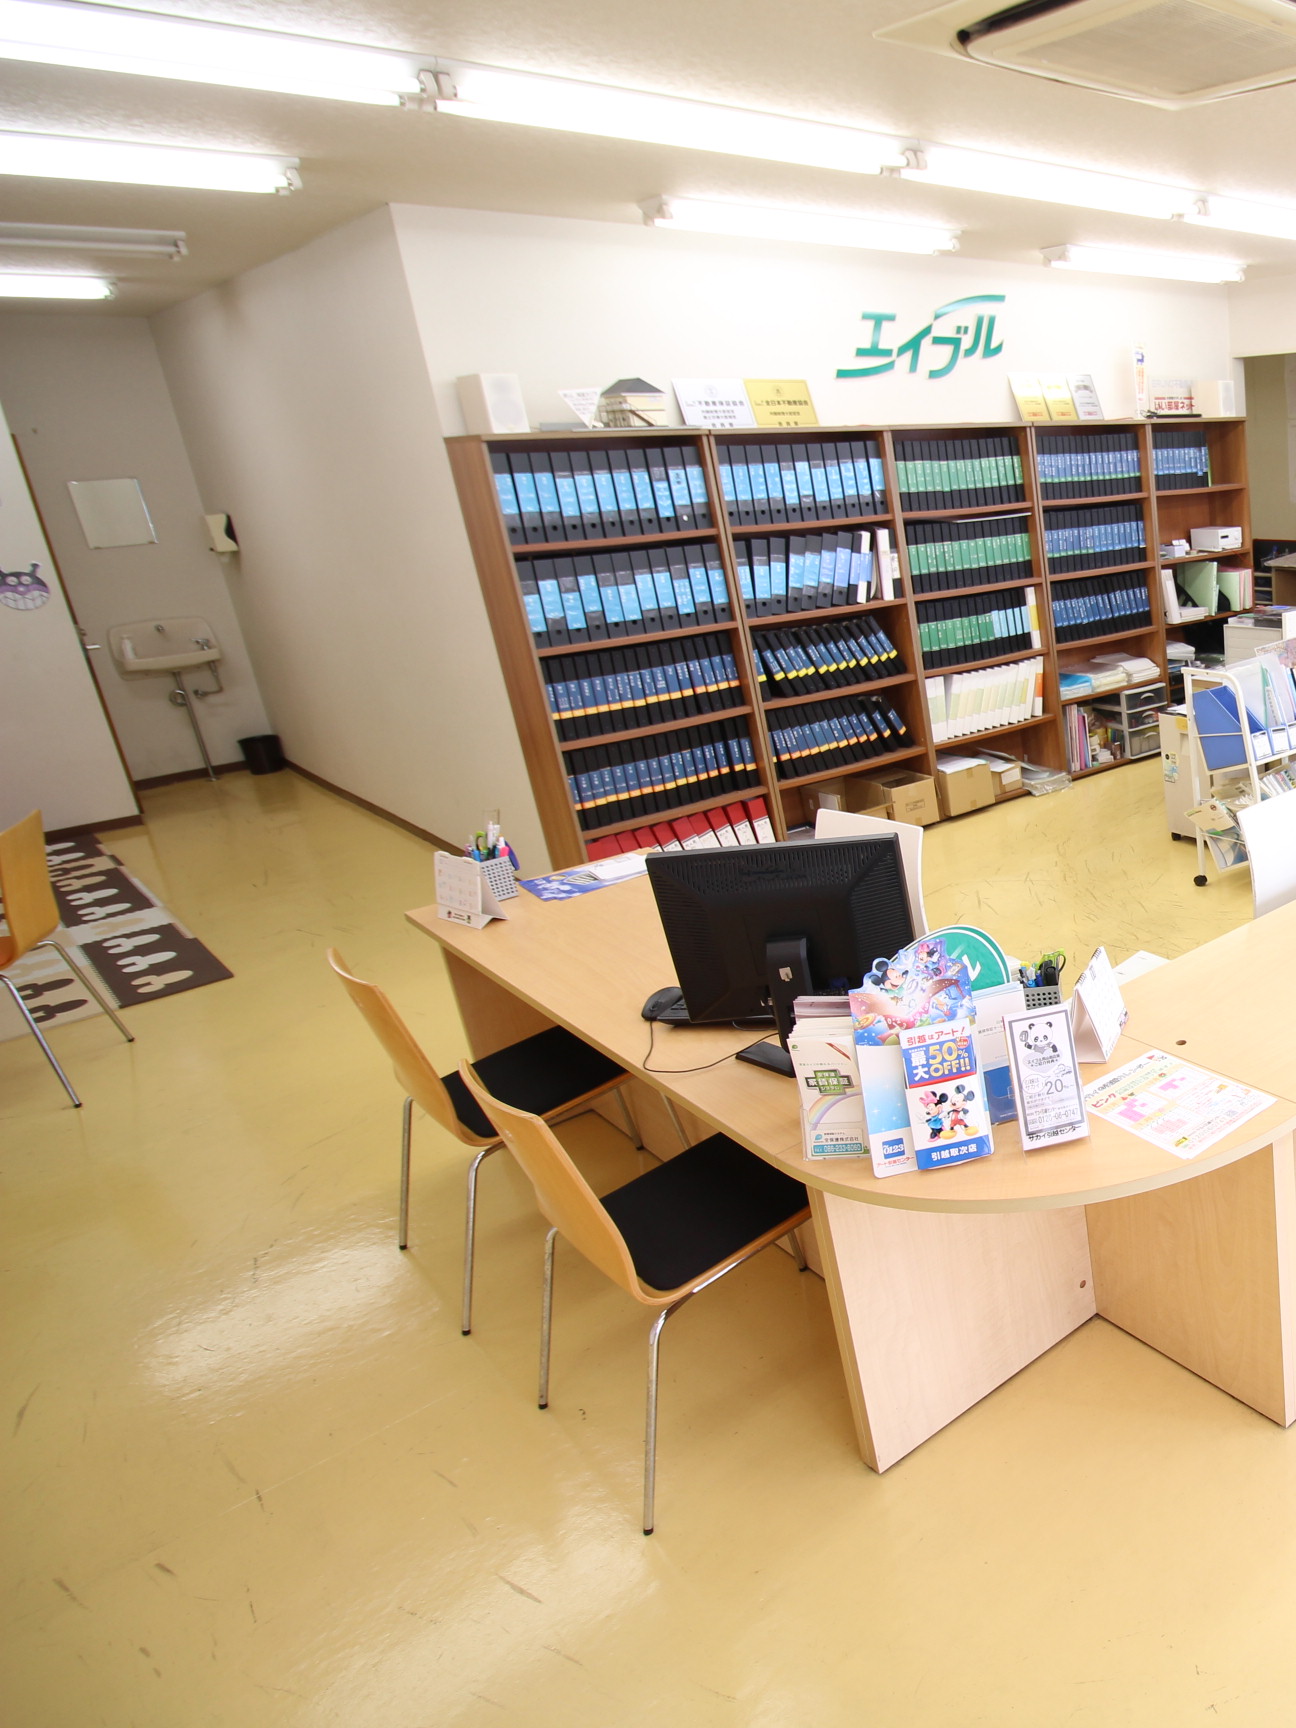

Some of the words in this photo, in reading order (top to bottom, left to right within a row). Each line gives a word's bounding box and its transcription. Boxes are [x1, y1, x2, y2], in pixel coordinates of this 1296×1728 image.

[836, 294, 1006, 380] エイブル
[906, 1026, 967, 1047] 引越はアート！
[929, 1042, 969, 1065] 50%
[929, 1057, 971, 1077] OFF!!
[807, 1076, 851, 1087] 家賃保証
[1045, 1078, 1065, 1096] 20
[1091, 1091, 1118, 1109] ピンク
[1028, 1125, 1082, 1142] サカイ引越センター
[931, 1144, 978, 1161] 引越取次店
